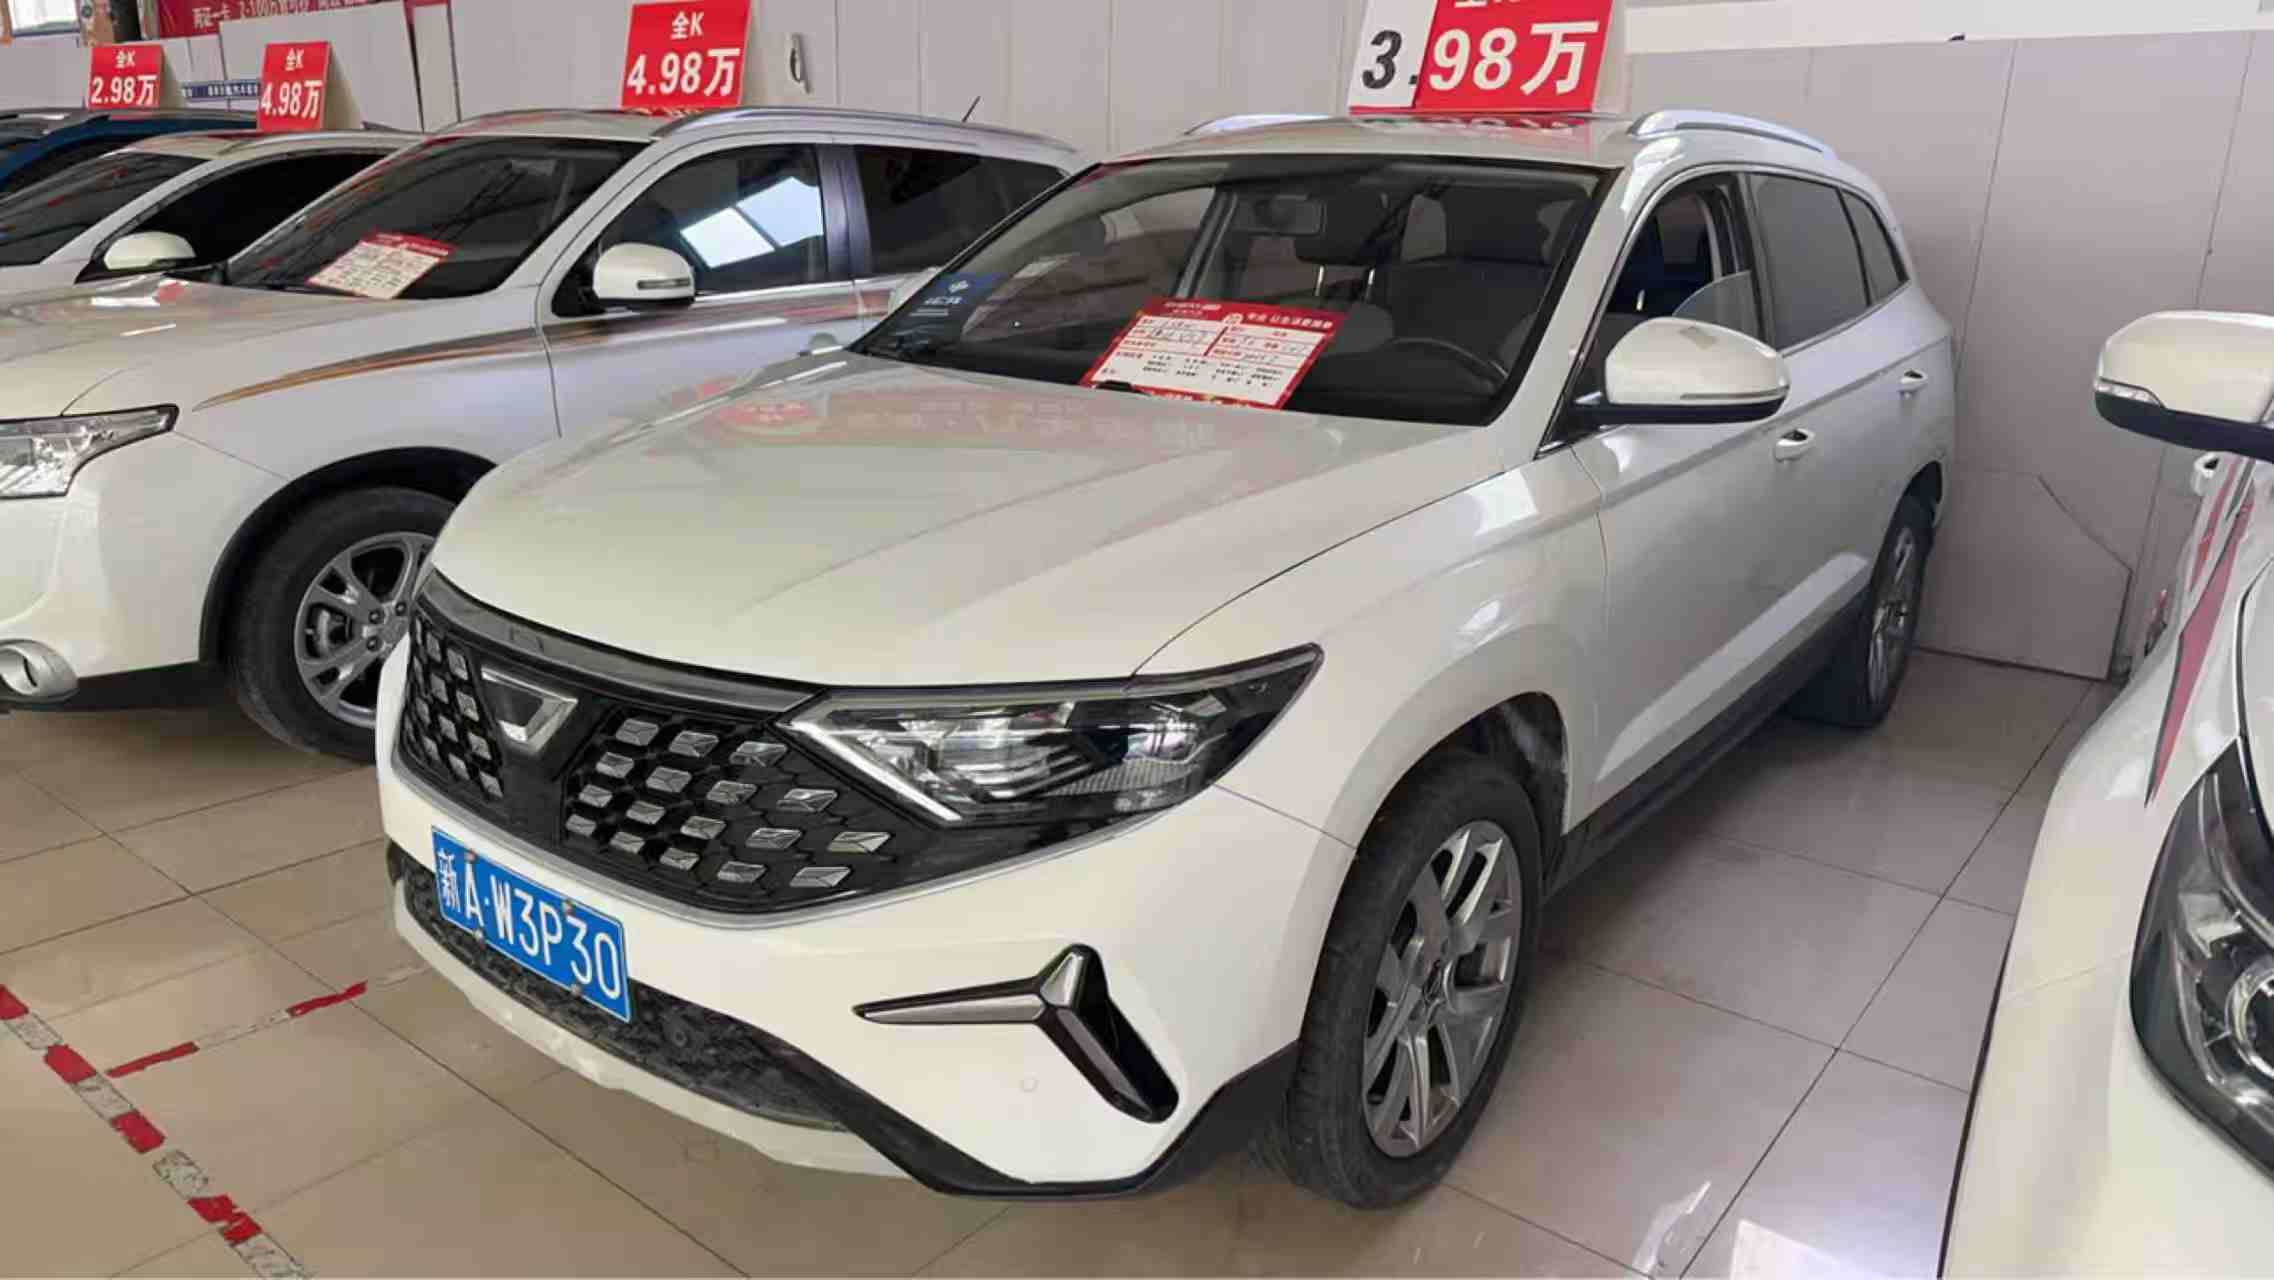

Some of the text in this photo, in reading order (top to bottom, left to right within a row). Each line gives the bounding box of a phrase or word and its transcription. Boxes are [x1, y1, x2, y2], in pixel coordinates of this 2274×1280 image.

[671, 11, 704, 39] 全K
[626, 47, 741, 96] 4.98万
[1362, 21, 1599, 95] 3.98万
[91, 74, 158, 106] 2.98万
[261, 79, 323, 119] 4.98万
